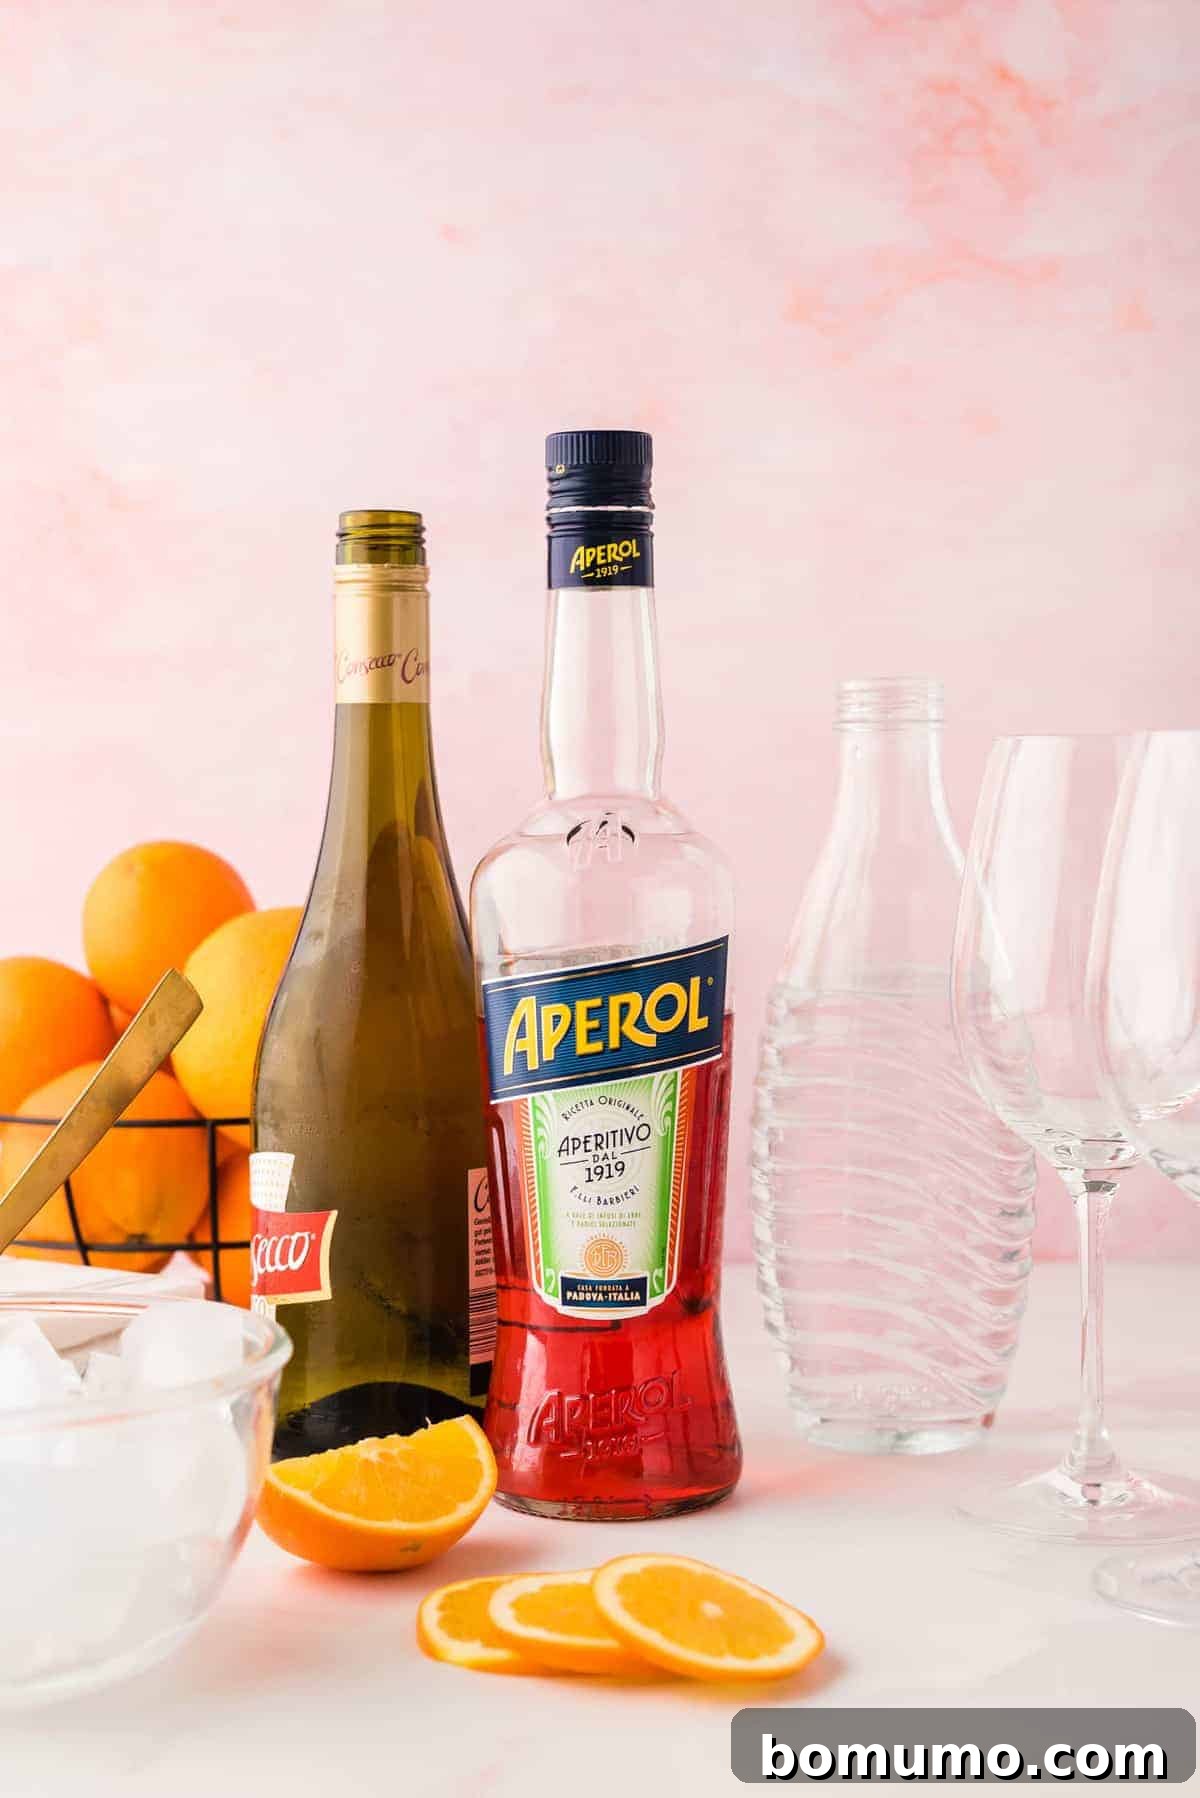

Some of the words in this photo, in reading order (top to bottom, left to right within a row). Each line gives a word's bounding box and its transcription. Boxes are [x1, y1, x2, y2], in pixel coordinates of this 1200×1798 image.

[569, 539, 641, 574] APEROL
[595, 564, 619, 578] 1919
[503, 976, 709, 1077] APEROL
[561, 1099, 595, 1122] RICETTA
[598, 1095, 645, 1121] ORIGINALE
[558, 1123, 651, 1158] APERITIVO
[592, 1152, 618, 1163] DAL
[585, 1161, 626, 1183] 1919
[596, 1185, 640, 1206] BARBIERI
[528, 1369, 693, 1446] APEROL
